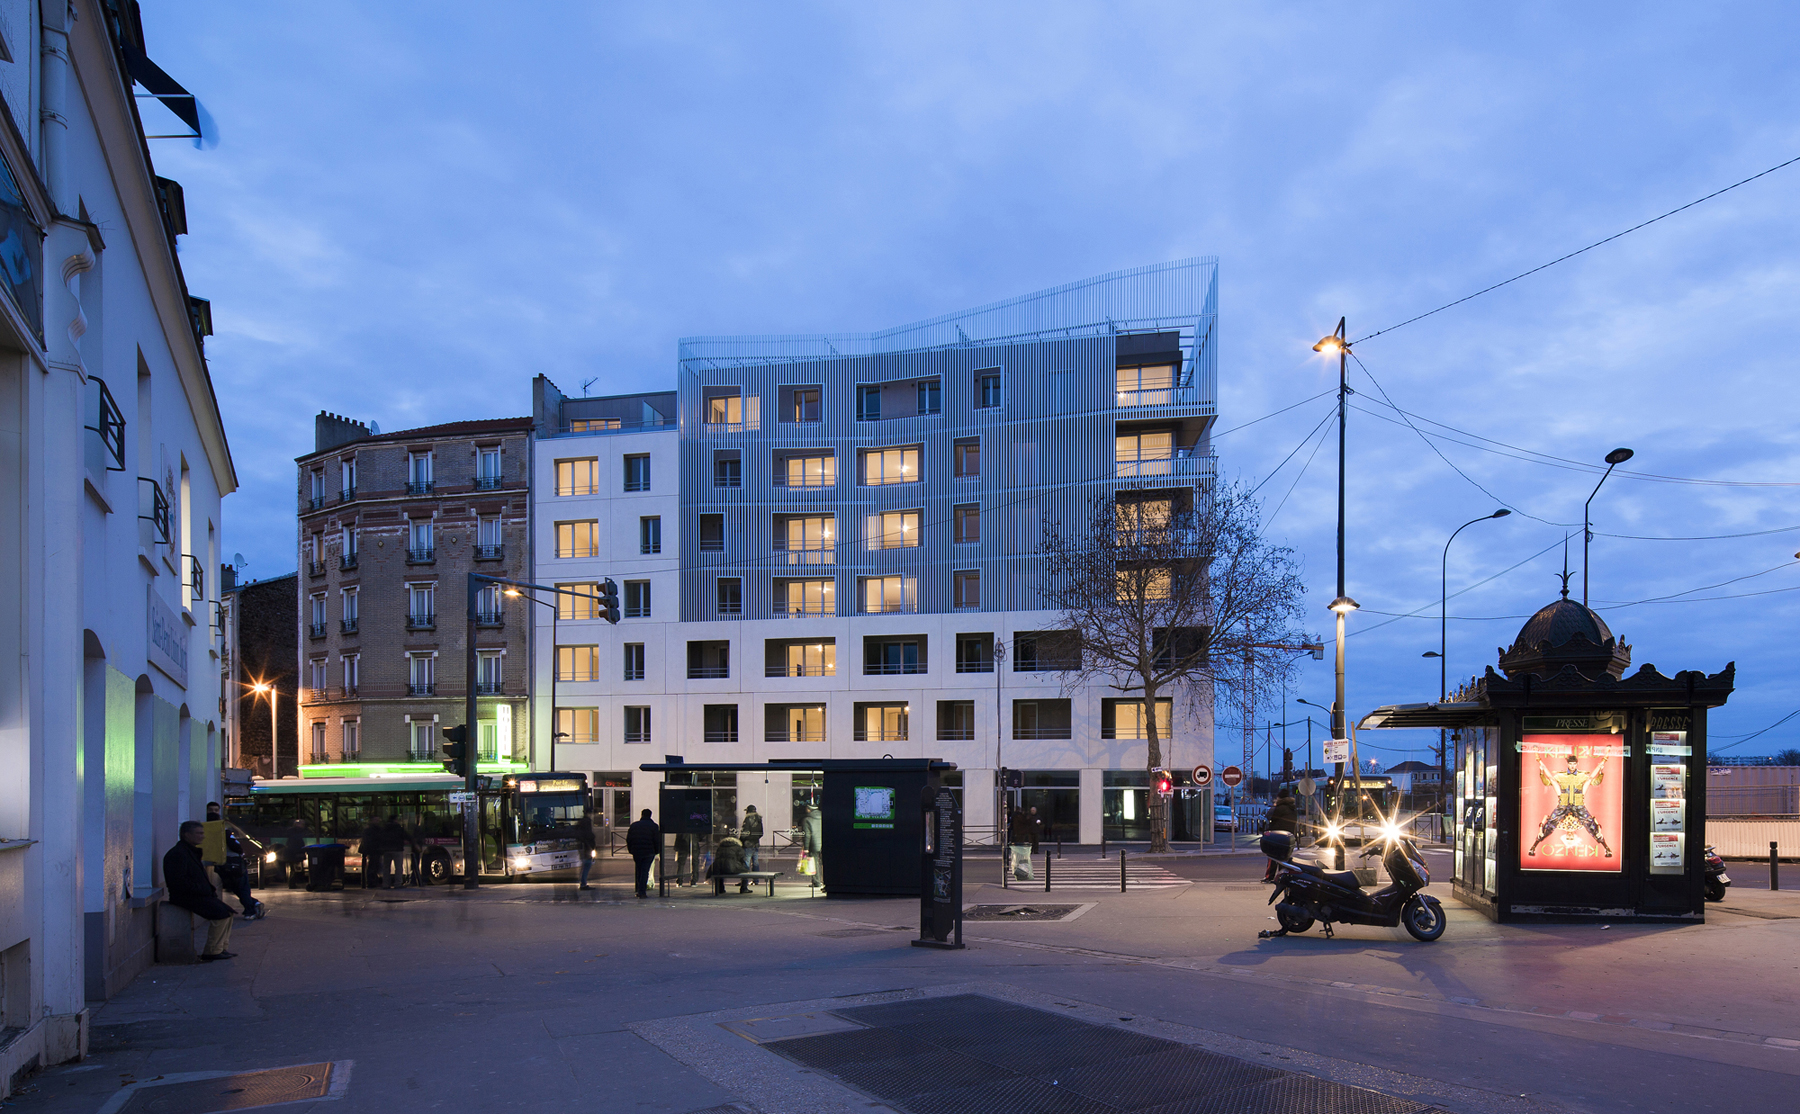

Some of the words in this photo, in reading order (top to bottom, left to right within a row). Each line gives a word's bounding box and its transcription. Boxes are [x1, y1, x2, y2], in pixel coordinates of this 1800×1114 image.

[1555, 718, 1589, 730] PRESSE
[1650, 715, 1689, 730] PRESSE
[1544, 745, 1602, 759] KENZO
[520, 782, 537, 792] 239
[1541, 844, 1598, 857] KENZO
